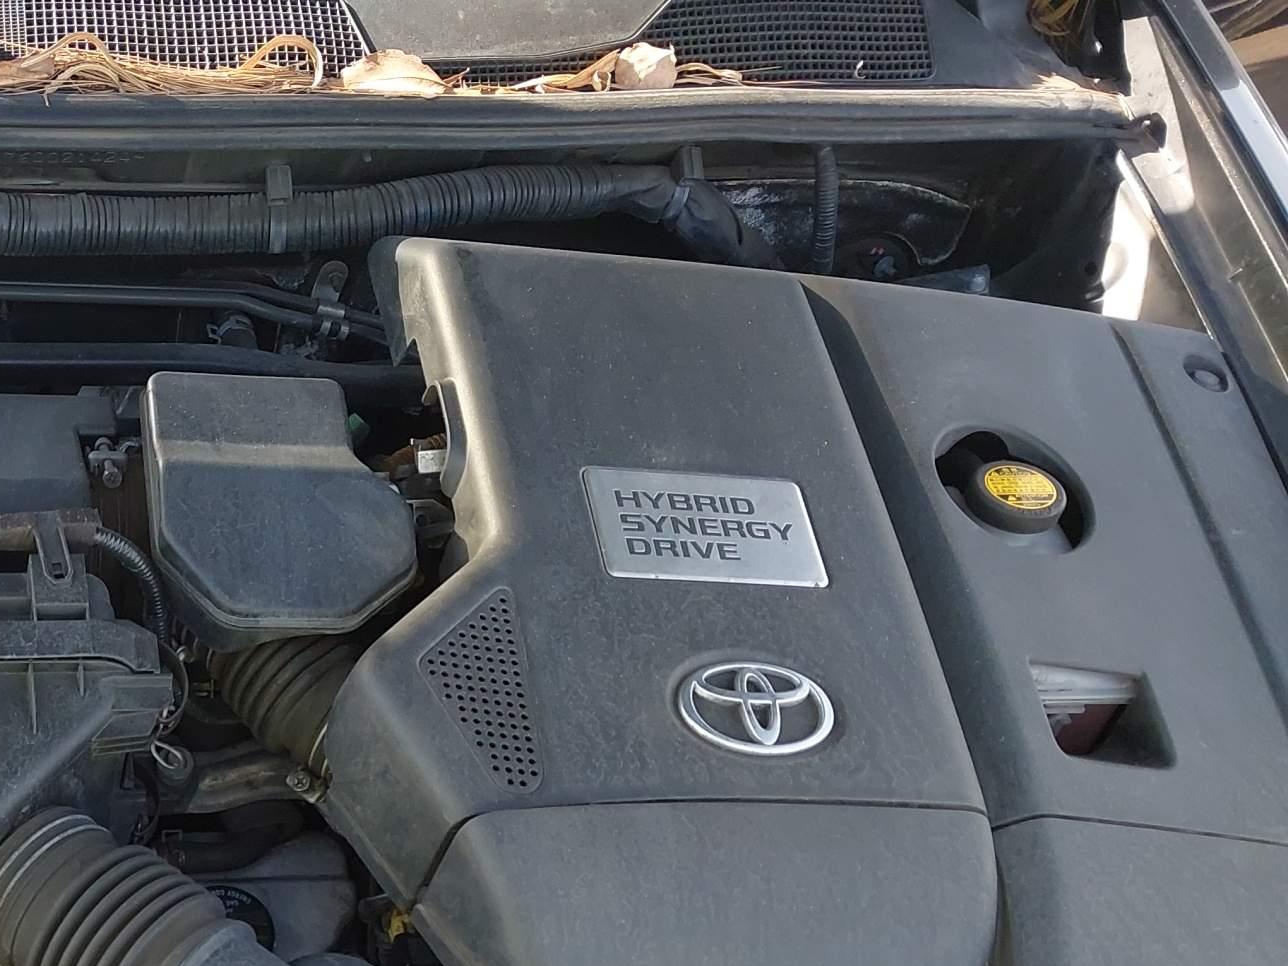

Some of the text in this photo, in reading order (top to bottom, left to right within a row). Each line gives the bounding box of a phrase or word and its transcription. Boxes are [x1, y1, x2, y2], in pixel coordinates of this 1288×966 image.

[614, 490, 755, 515] HYBRID
[619, 513, 793, 541] SYNERGY
[625, 537, 741, 560] DRIVE
